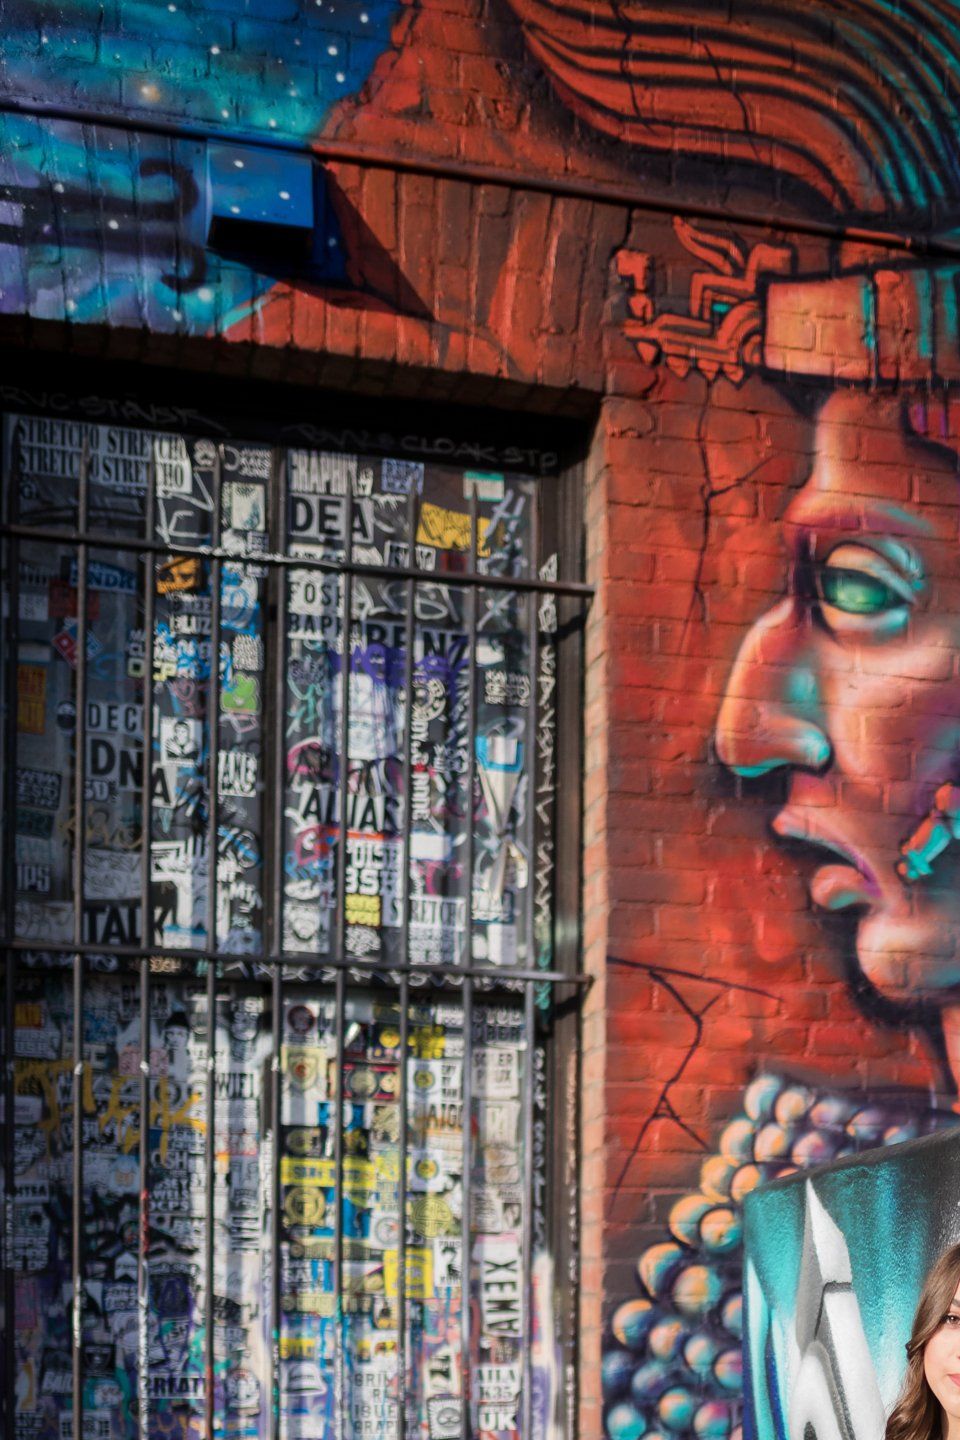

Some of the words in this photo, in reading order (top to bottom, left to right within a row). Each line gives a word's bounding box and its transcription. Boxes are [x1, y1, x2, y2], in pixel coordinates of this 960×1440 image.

[19, 446, 100, 482] STRETCO
[103, 454, 184, 490] STRECHO
[90, 738, 171, 804] DNA
[486, 1259, 521, 1337] AMEX
[480, 1411, 516, 1432] UK
